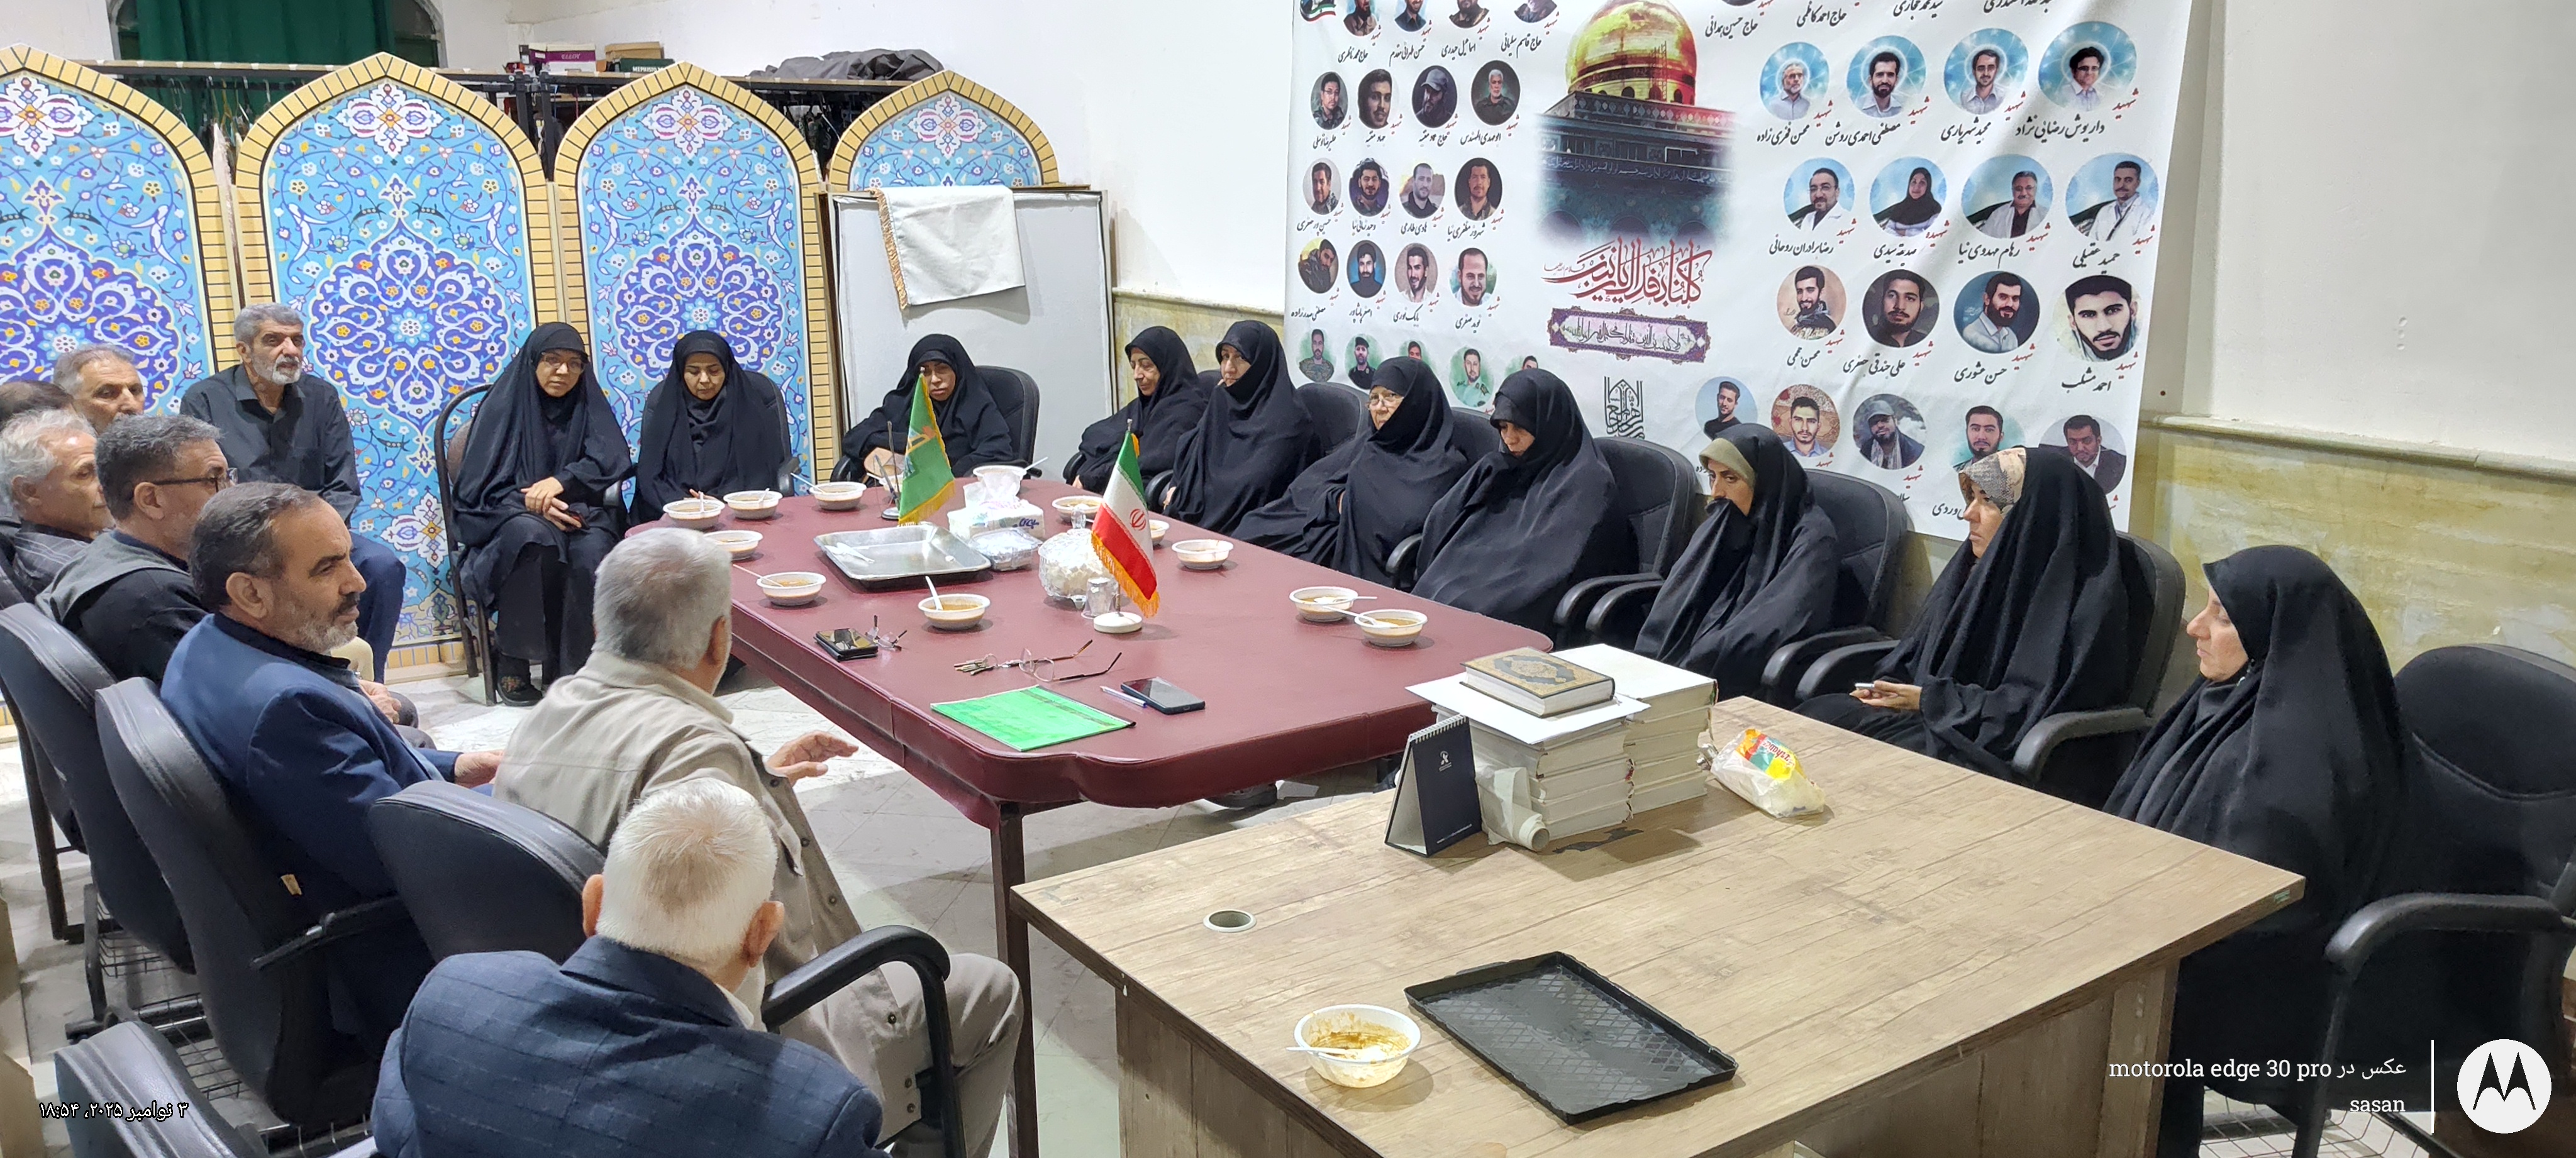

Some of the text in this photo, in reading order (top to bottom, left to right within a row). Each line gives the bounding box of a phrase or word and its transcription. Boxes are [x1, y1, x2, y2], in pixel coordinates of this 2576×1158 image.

[1797, 1, 1847, 28] حاج احمد کاظمی
[1705, 16, 1758, 39] حاج حسین همدانی
[1358, 49, 1368, 63] حاج
[1414, 43, 1426, 60] حسن
[1441, 38, 1476, 60] اسماعیل حیدری
[1501, 33, 1541, 58] حاج قاسم سلیمانی
[1814, 100, 1833, 128] شهید
[1908, 96, 1929, 125] شهید
[2004, 91, 2026, 121] شهید
[2112, 87, 2139, 119] شهید
[1757, 121, 1810, 146] محسن فخری زاده
[1825, 121, 1901, 146] مصطفی احمدی روشن
[1940, 116, 1992, 144] مجید شهریاری
[2015, 114, 2038, 136] نژاد
[2065, 113, 2105, 143] داریوش
[1437, 133, 1448, 147] حاج
[1836, 218, 1857, 244] شهید
[2026, 222, 2051, 251] شهید
[2132, 224, 2155, 254] شهید
[1768, 233, 1794, 255] روحانی
[1958, 241, 1970, 264] نیا
[1968, 244, 2000, 260] مهدوی
[2072, 242, 2120, 275] حمید عقیلی
[1825, 329, 1845, 353] شهید
[1801, 350, 1821, 368] محسن
[1913, 341, 1934, 367] شهید
[2011, 343, 2035, 371] شهید
[2116, 351, 2138, 380] شهید
[1889, 360, 1906, 377] علی
[1984, 368, 2007, 385] حسن
[2092, 380, 2112, 392] احمد
[1903, 465, 1923, 489] شهید
